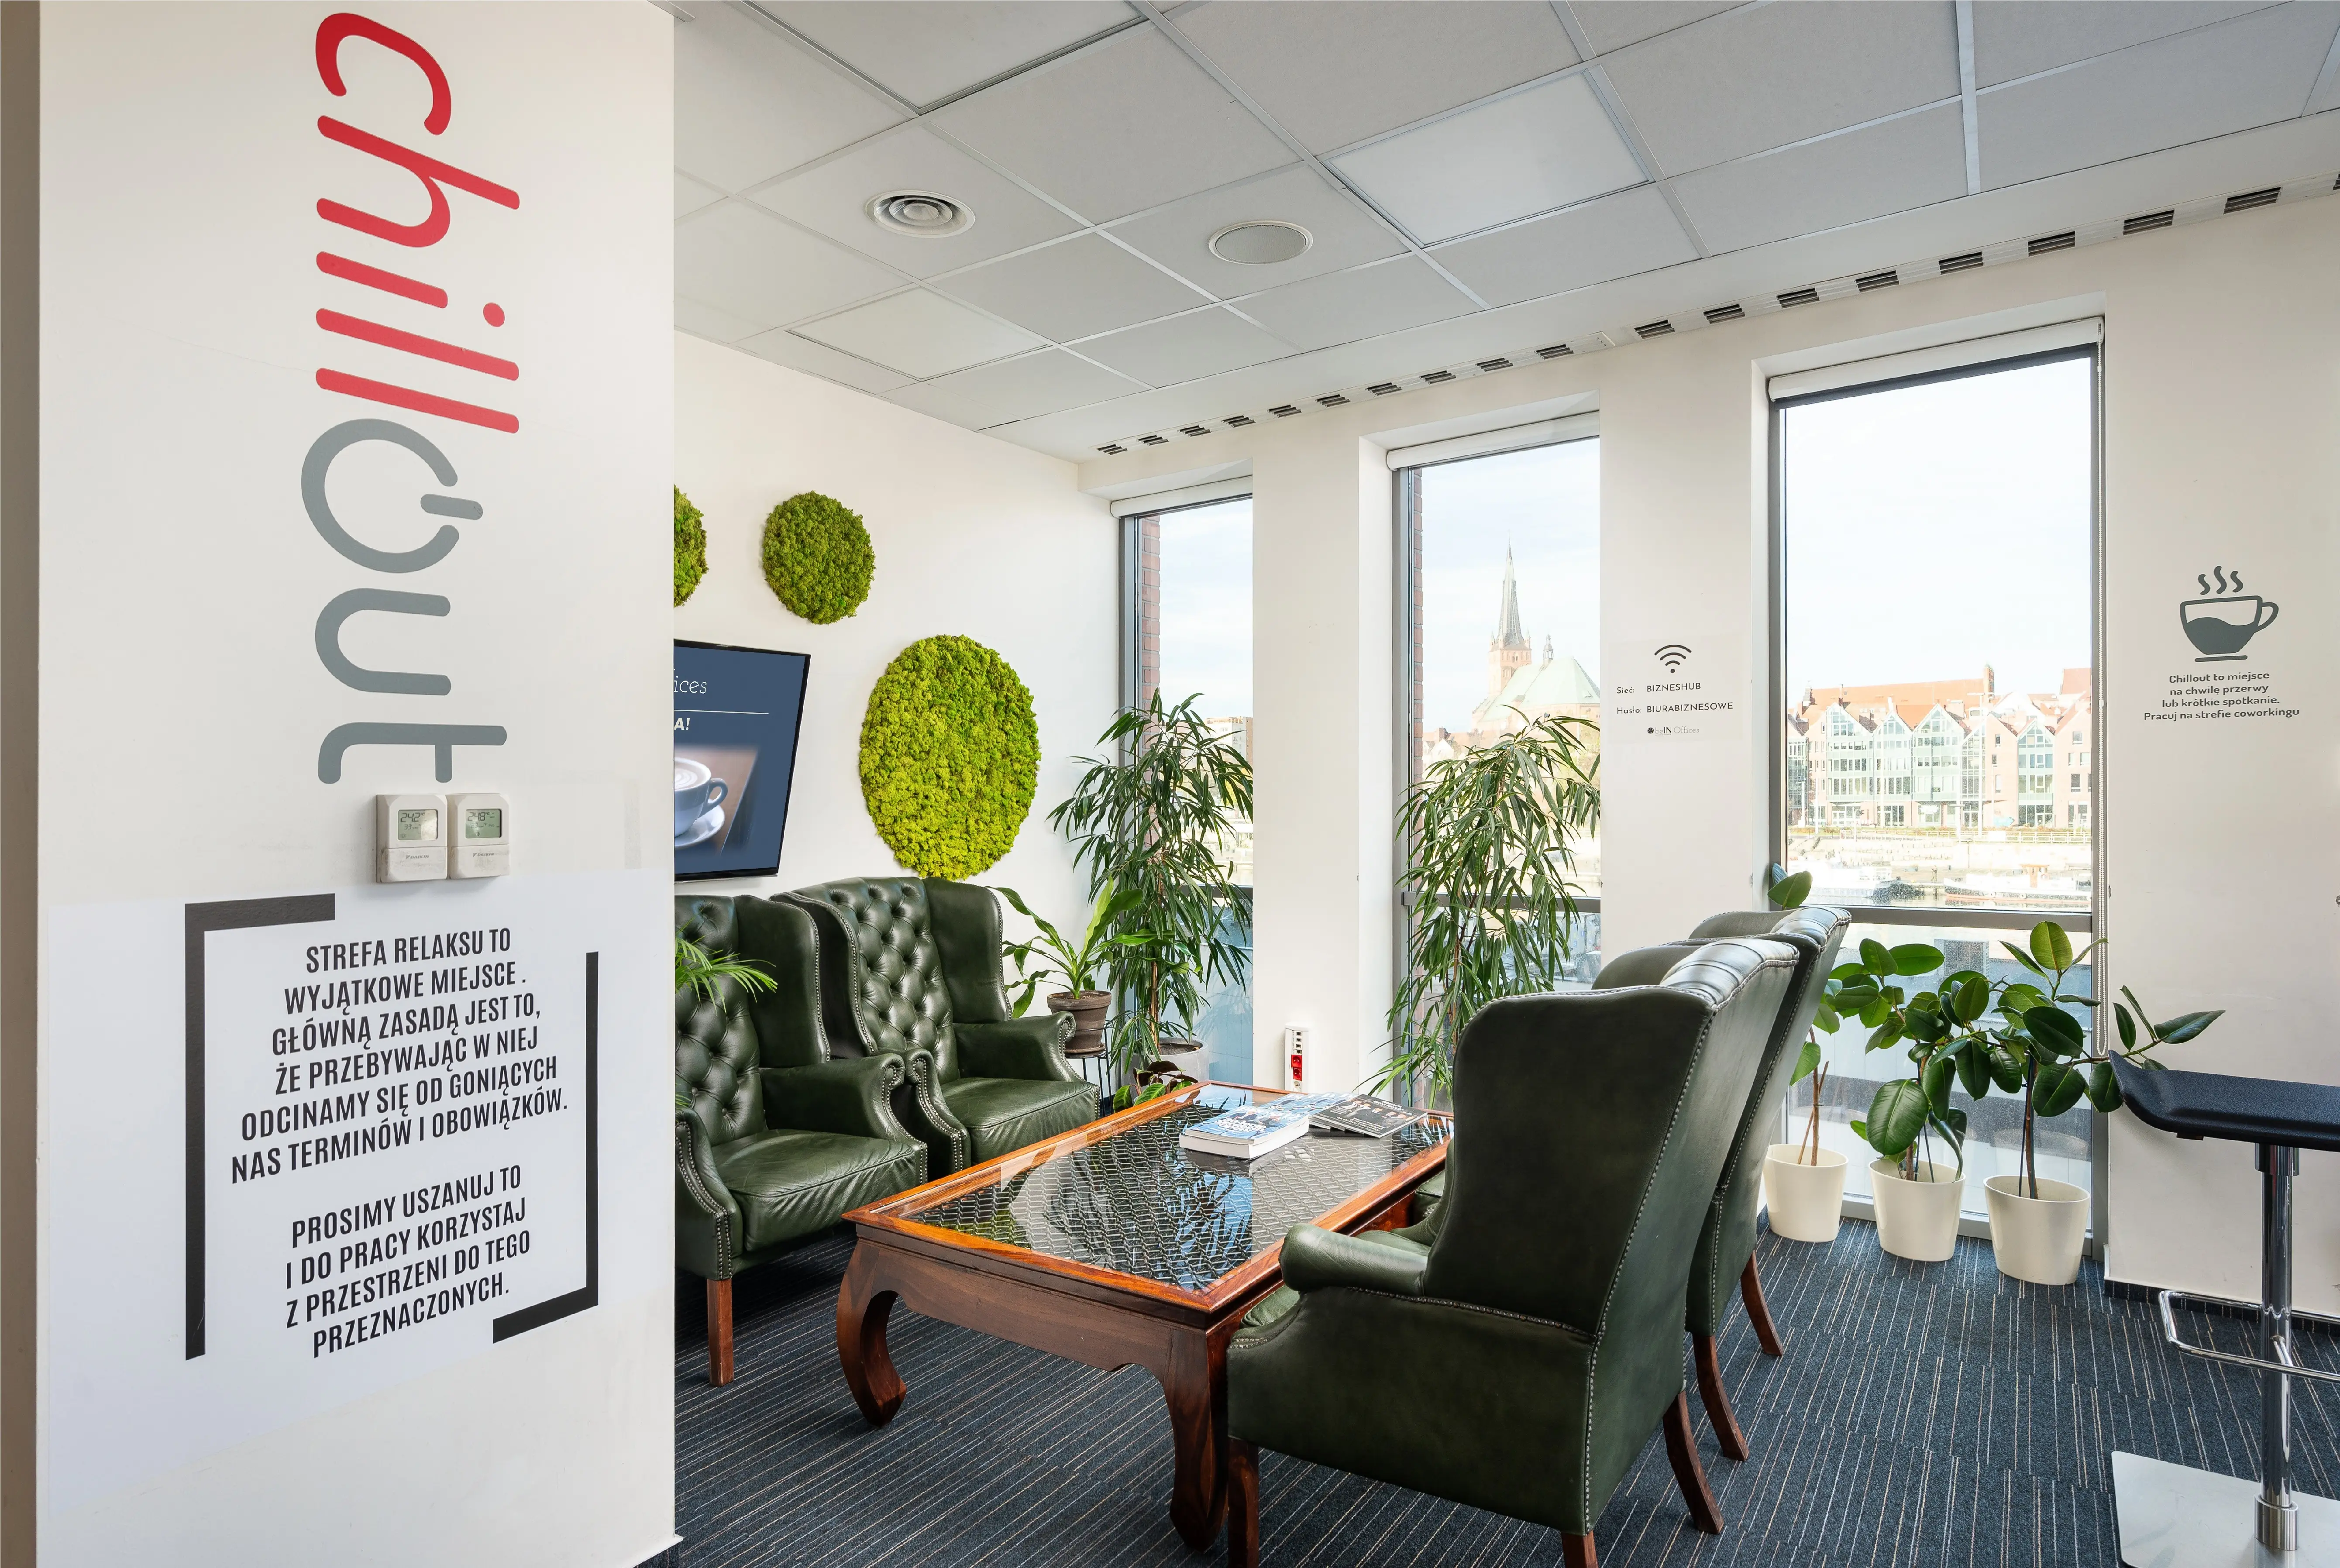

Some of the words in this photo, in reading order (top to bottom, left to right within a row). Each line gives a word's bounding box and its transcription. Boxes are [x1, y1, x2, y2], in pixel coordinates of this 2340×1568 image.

[674, 675, 707, 694] ices
[1647, 683, 1701, 692] BIZNESHUB
[2162, 699, 2178, 708] lub
[2182, 698, 2220, 707] krótkie
[2222, 696, 2280, 707] spotkanie.
[2169, 674, 2211, 683] Chillout
[2228, 671, 2270, 682] miejsce
[2185, 685, 2220, 695] chwilę
[2223, 686, 2269, 695] przerwy
[1617, 706, 1641, 715] Hasło:
[1647, 702, 1733, 713] BIURABIZNESOWE
[2144, 712, 2177, 722] Pracuj
[2195, 709, 2231, 719] strefie
[2234, 708, 2299, 718] coworkingu
[306, 939, 387, 973] STREFA
[394, 930, 483, 964] RELAKSU
[489, 927, 511, 953] TO
[284, 972, 424, 1016] WYJĄTKOWE
[431, 961, 516, 996] MIEJSCE
[272, 1015, 372, 1056] GŁÓWNĄ
[379, 1003, 459, 1040] ZASADĄ
[465, 996, 509, 1025] JEST
[513, 992, 540, 1019] TO,
[275, 1062, 301, 1096] ŻE
[309, 1037, 467, 1090] PRZEBYWAJĄC
[473, 1033, 491, 1059] W
[497, 1025, 537, 1056] NIEJ
[241, 1090, 370, 1141] ODCINAMY
[376, 1083, 409, 1118] SIĘ
[416, 1077, 443, 1106] OD
[450, 1055, 557, 1099] GONIĄCYCH
[232, 1147, 281, 1184] NAS
[287, 1117, 412, 1171] TERMINÓW
[419, 1116, 424, 1142] I
[432, 1085, 568, 1138] OBOWIĄZKÓW.
[292, 1195, 396, 1249] PROSIMY
[403, 1170, 494, 1218] USZANUJ
[499, 1164, 521, 1192] TO
[286, 1262, 292, 1290] I
[301, 1251, 331, 1285] DO
[340, 1228, 411, 1274] PRACY
[417, 1197, 526, 1251] KORZYSTAJ
[286, 1299, 298, 1329] Z
[306, 1254, 447, 1323] PRZESTRZENI
[454, 1245, 480, 1276] DO
[485, 1230, 530, 1265] TEGO
[313, 1271, 509, 1359] PRZEZNACZONYCH.
